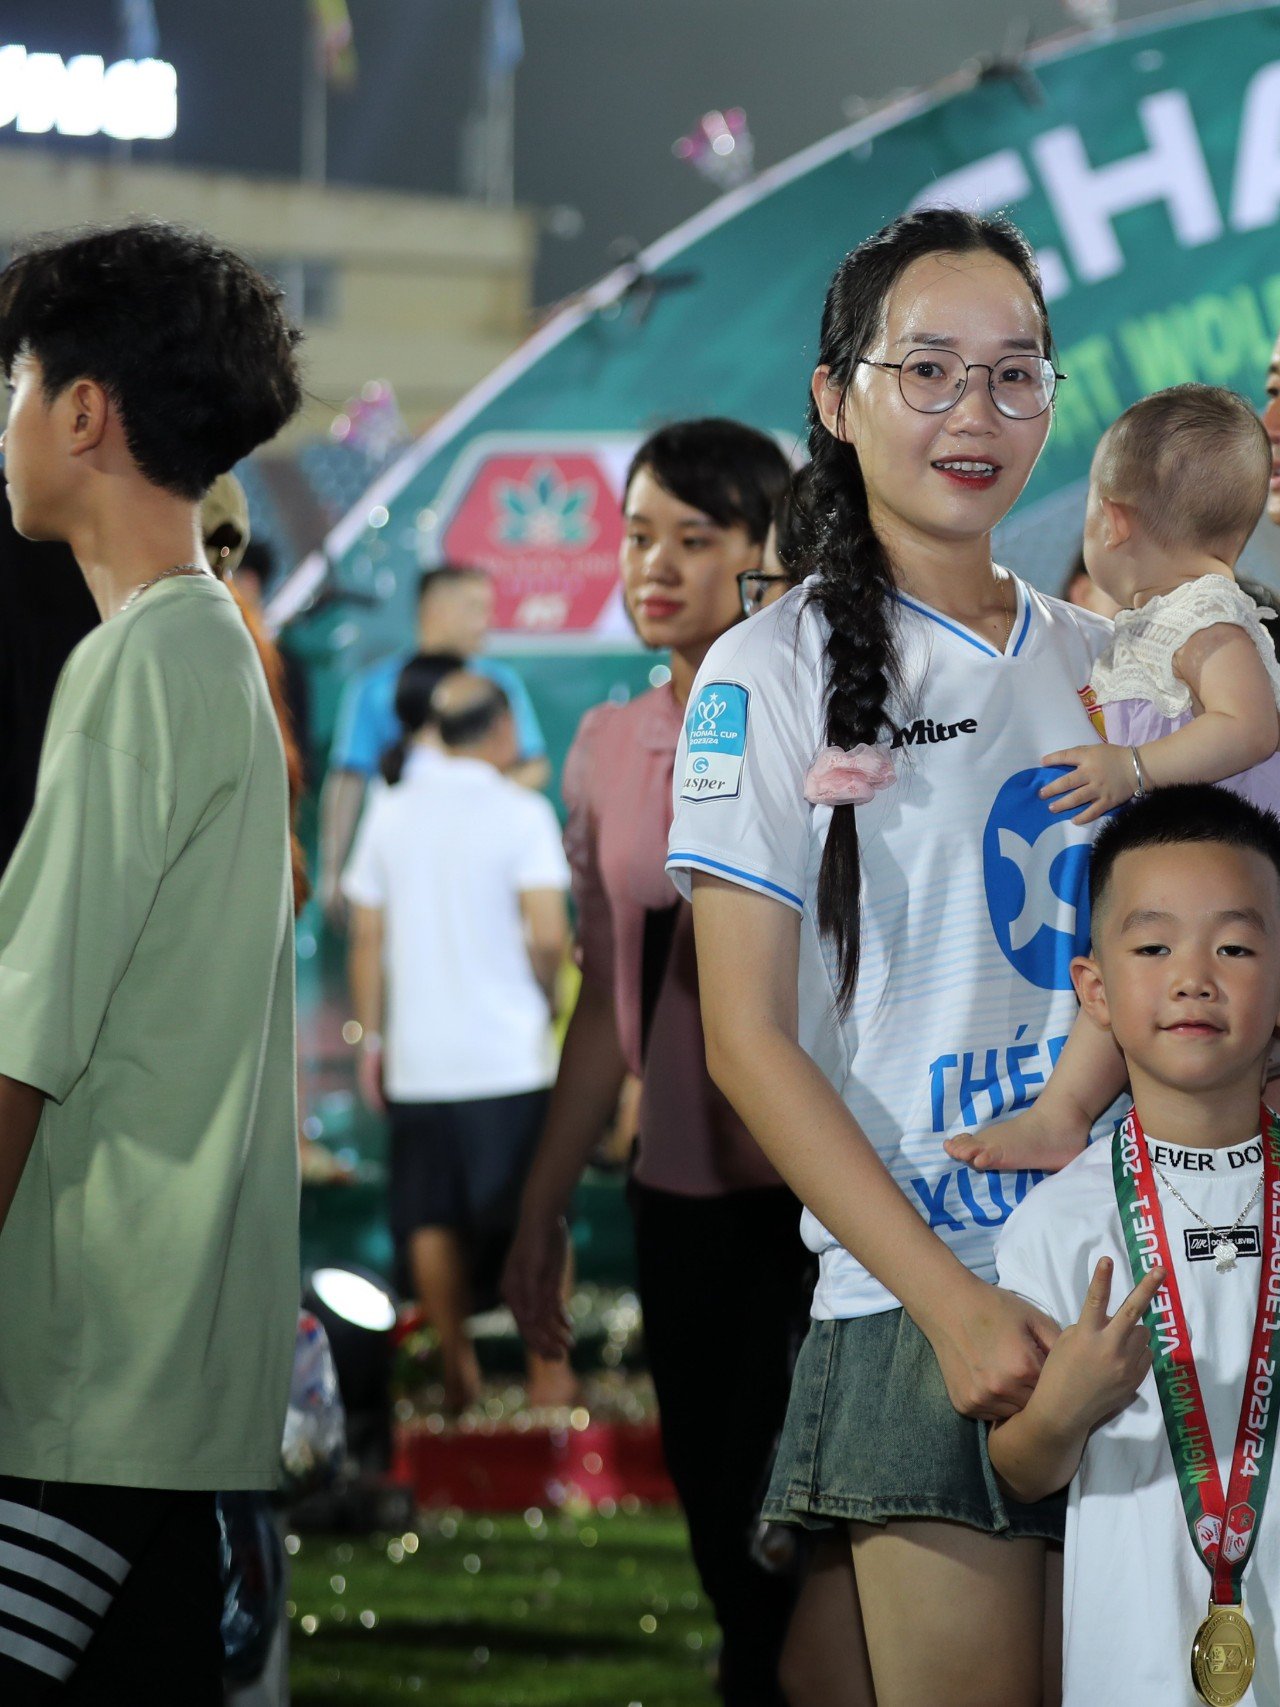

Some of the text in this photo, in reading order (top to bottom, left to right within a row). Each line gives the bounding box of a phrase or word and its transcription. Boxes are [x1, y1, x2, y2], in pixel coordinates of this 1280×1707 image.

[720, 731, 738, 739] CUP
[889, 718, 978, 750] Mitre
[1164, 1362, 1200, 1417] WOLF
[1239, 1357, 1276, 1478] 2023/24
[1178, 1425, 1213, 1485] NIGHT
